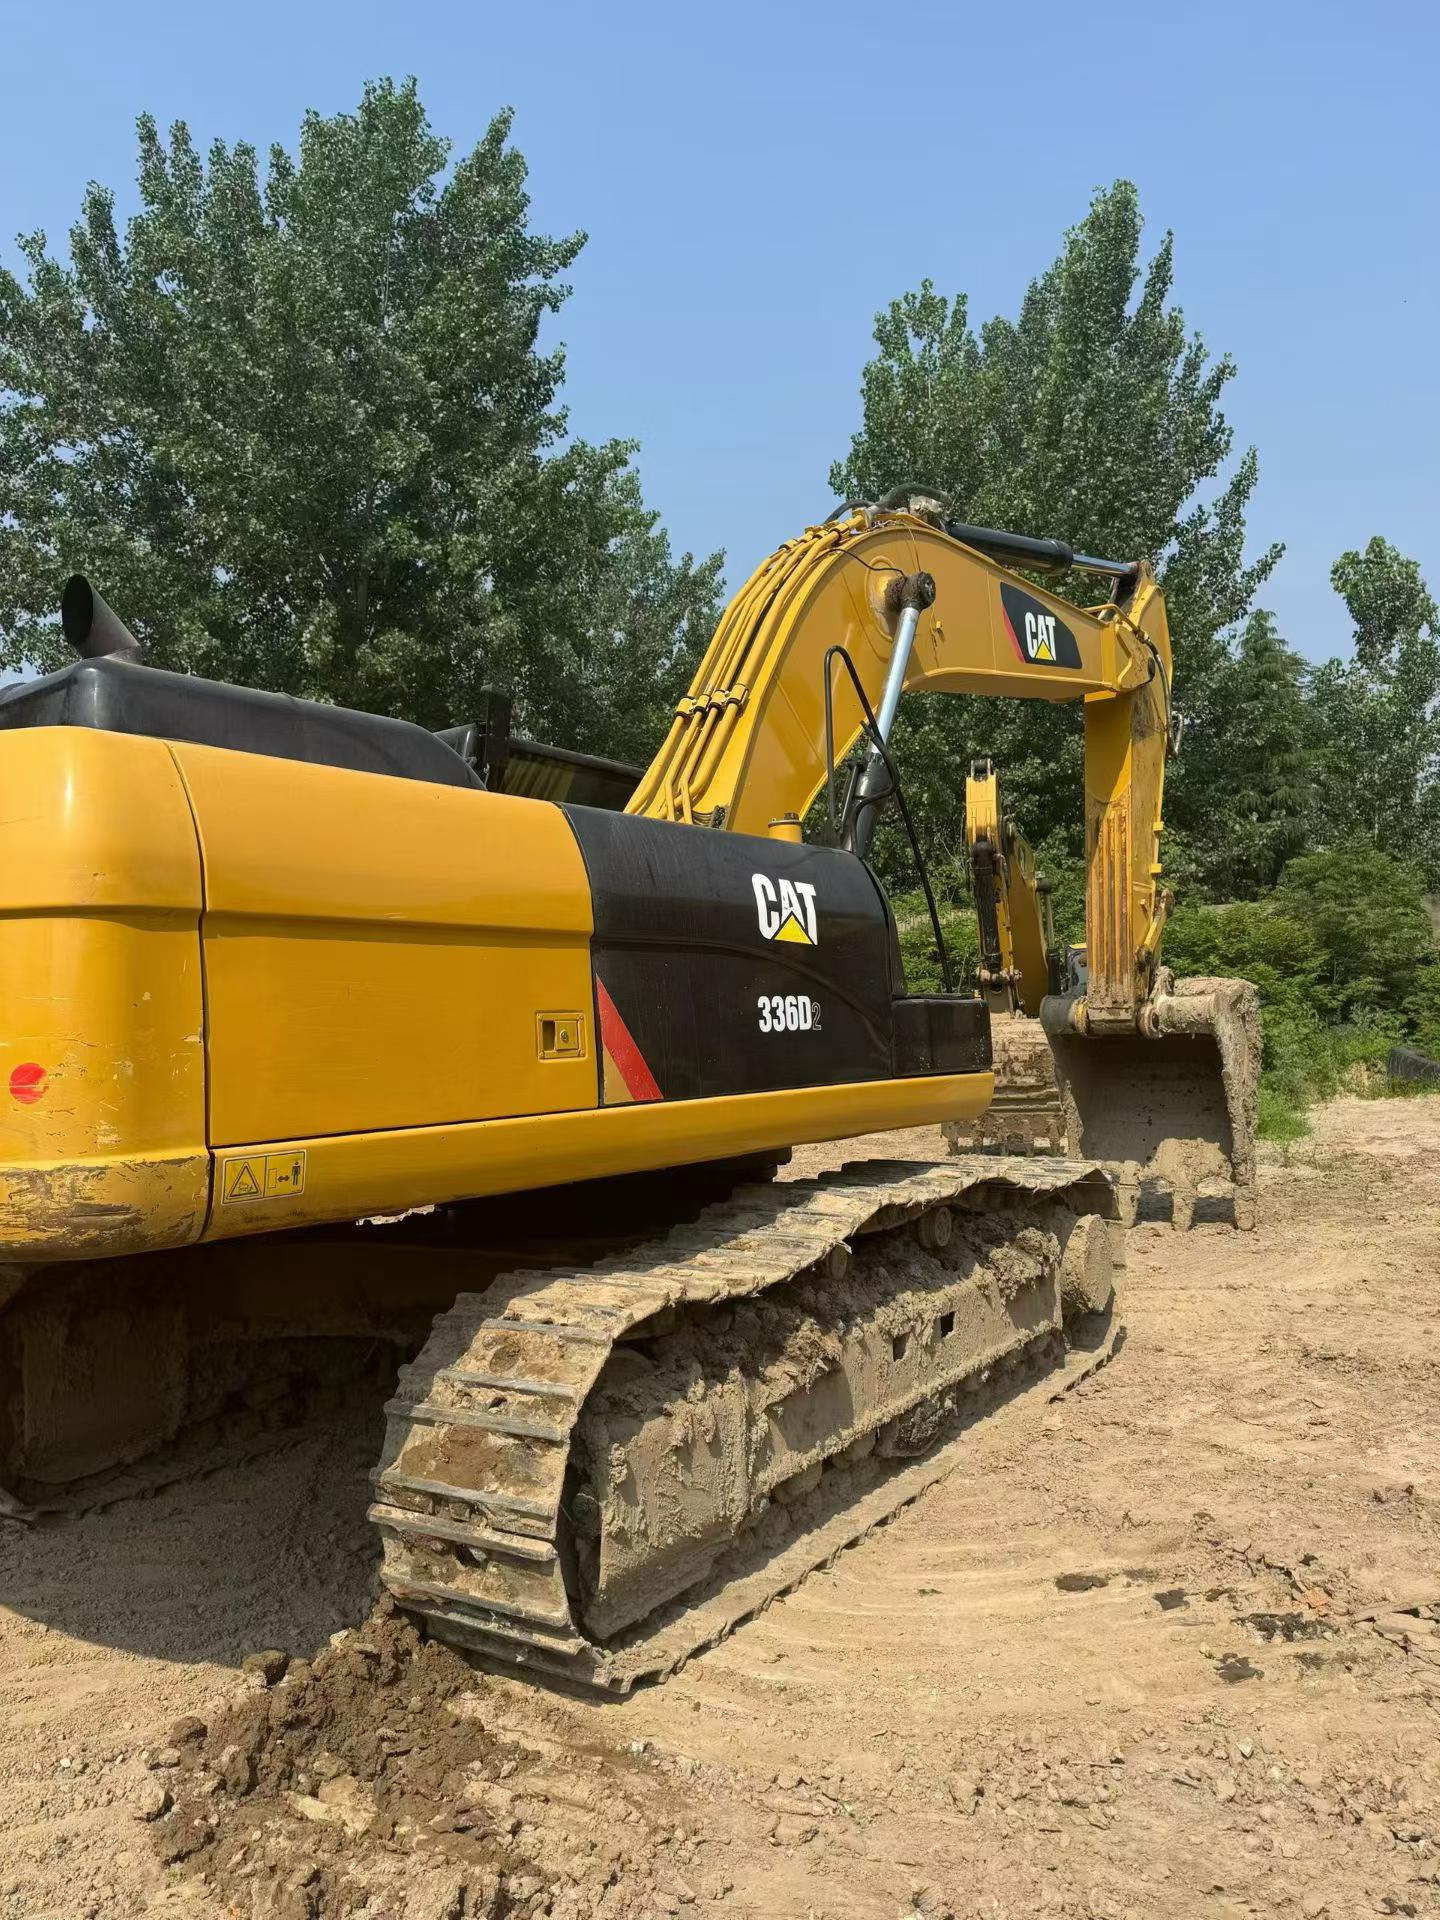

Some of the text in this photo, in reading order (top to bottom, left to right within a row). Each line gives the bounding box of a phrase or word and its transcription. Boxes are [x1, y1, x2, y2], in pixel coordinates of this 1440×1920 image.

[1025, 612, 1056, 661] CAT
[751, 873, 818, 945] CAT
[757, 995, 822, 1032] 336D2
